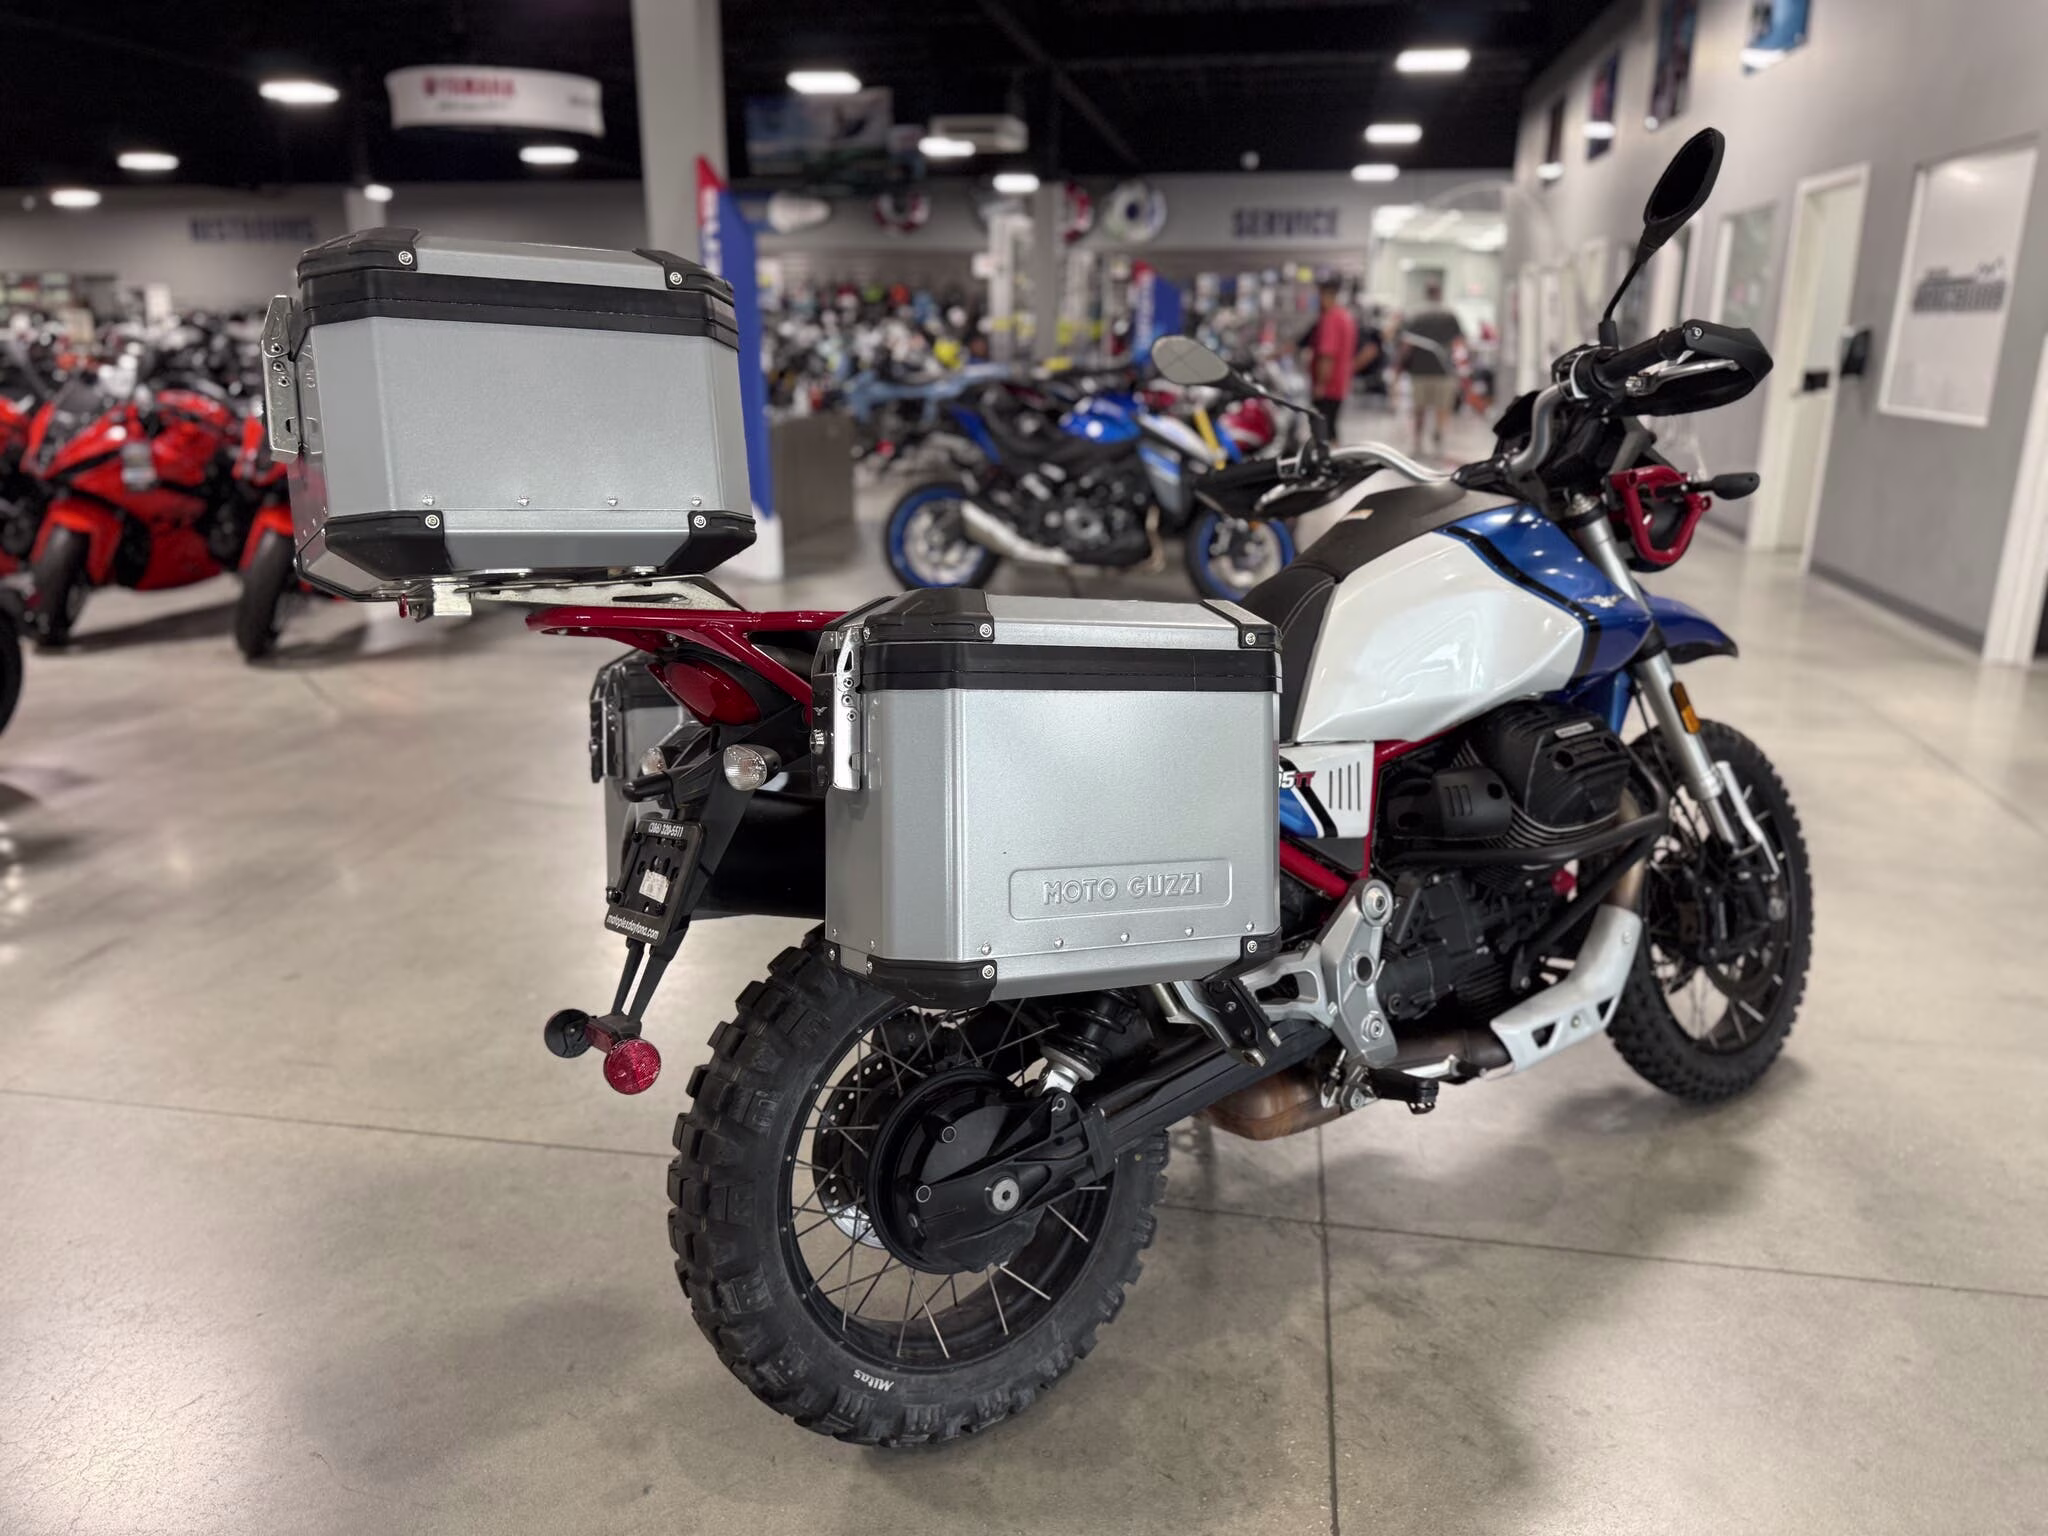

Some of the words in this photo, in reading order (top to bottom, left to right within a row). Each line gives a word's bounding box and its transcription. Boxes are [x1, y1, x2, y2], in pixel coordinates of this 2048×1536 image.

[1232, 207, 1339, 238] SERVICE
[1043, 878, 1119, 905] MOTO
[1127, 872, 1203, 899] GUZZI
[853, 1369, 895, 1392] Mitas
